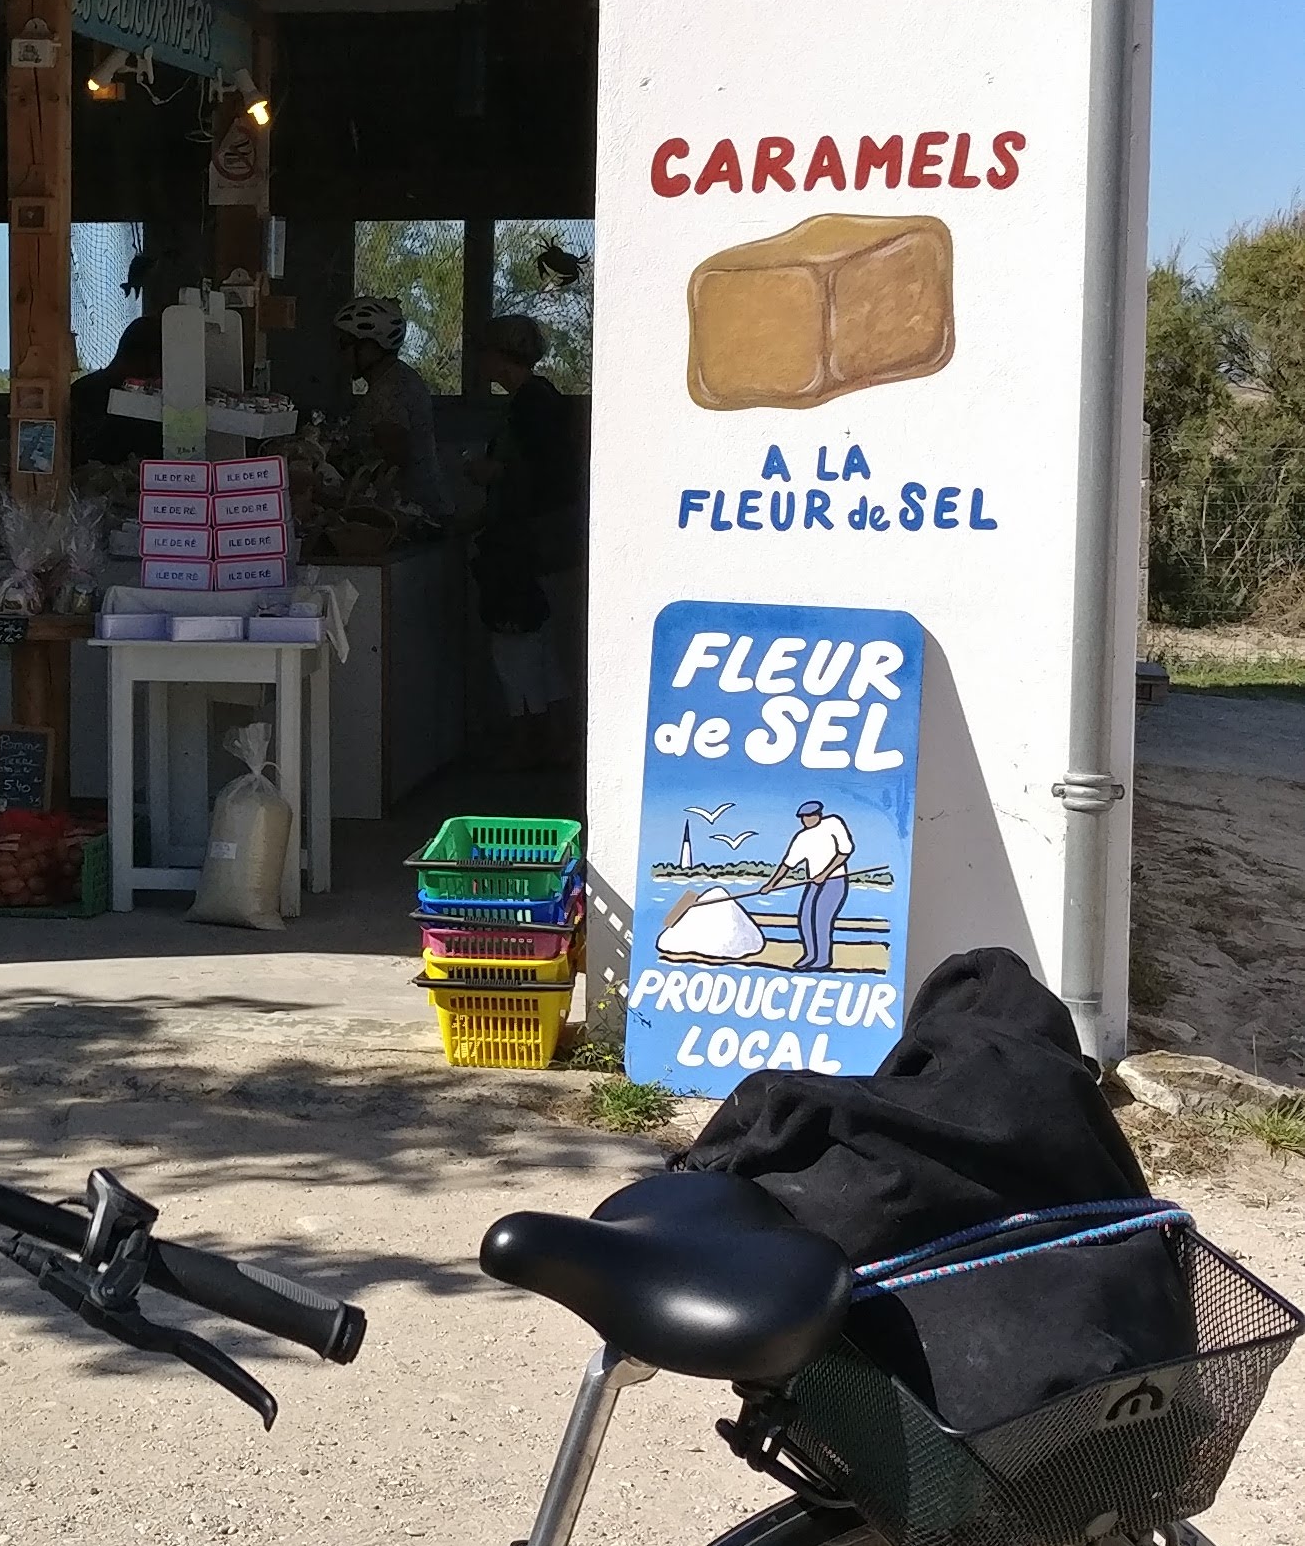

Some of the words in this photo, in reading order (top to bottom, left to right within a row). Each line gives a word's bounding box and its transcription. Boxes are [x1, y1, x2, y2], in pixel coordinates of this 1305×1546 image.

[650, 130, 1027, 198] CARAMELS
[816, 444, 871, 481] LA
[678, 488, 834, 532] FLEUR
[847, 496, 891, 531] de
[899, 481, 998, 531] SEL
[671, 631, 905, 701] FLEUR
[653, 709, 731, 759] de
[744, 695, 905, 773] SEL
[630, 968, 897, 1030] PRODUCTEUR
[676, 1024, 843, 1076] LOCAL
